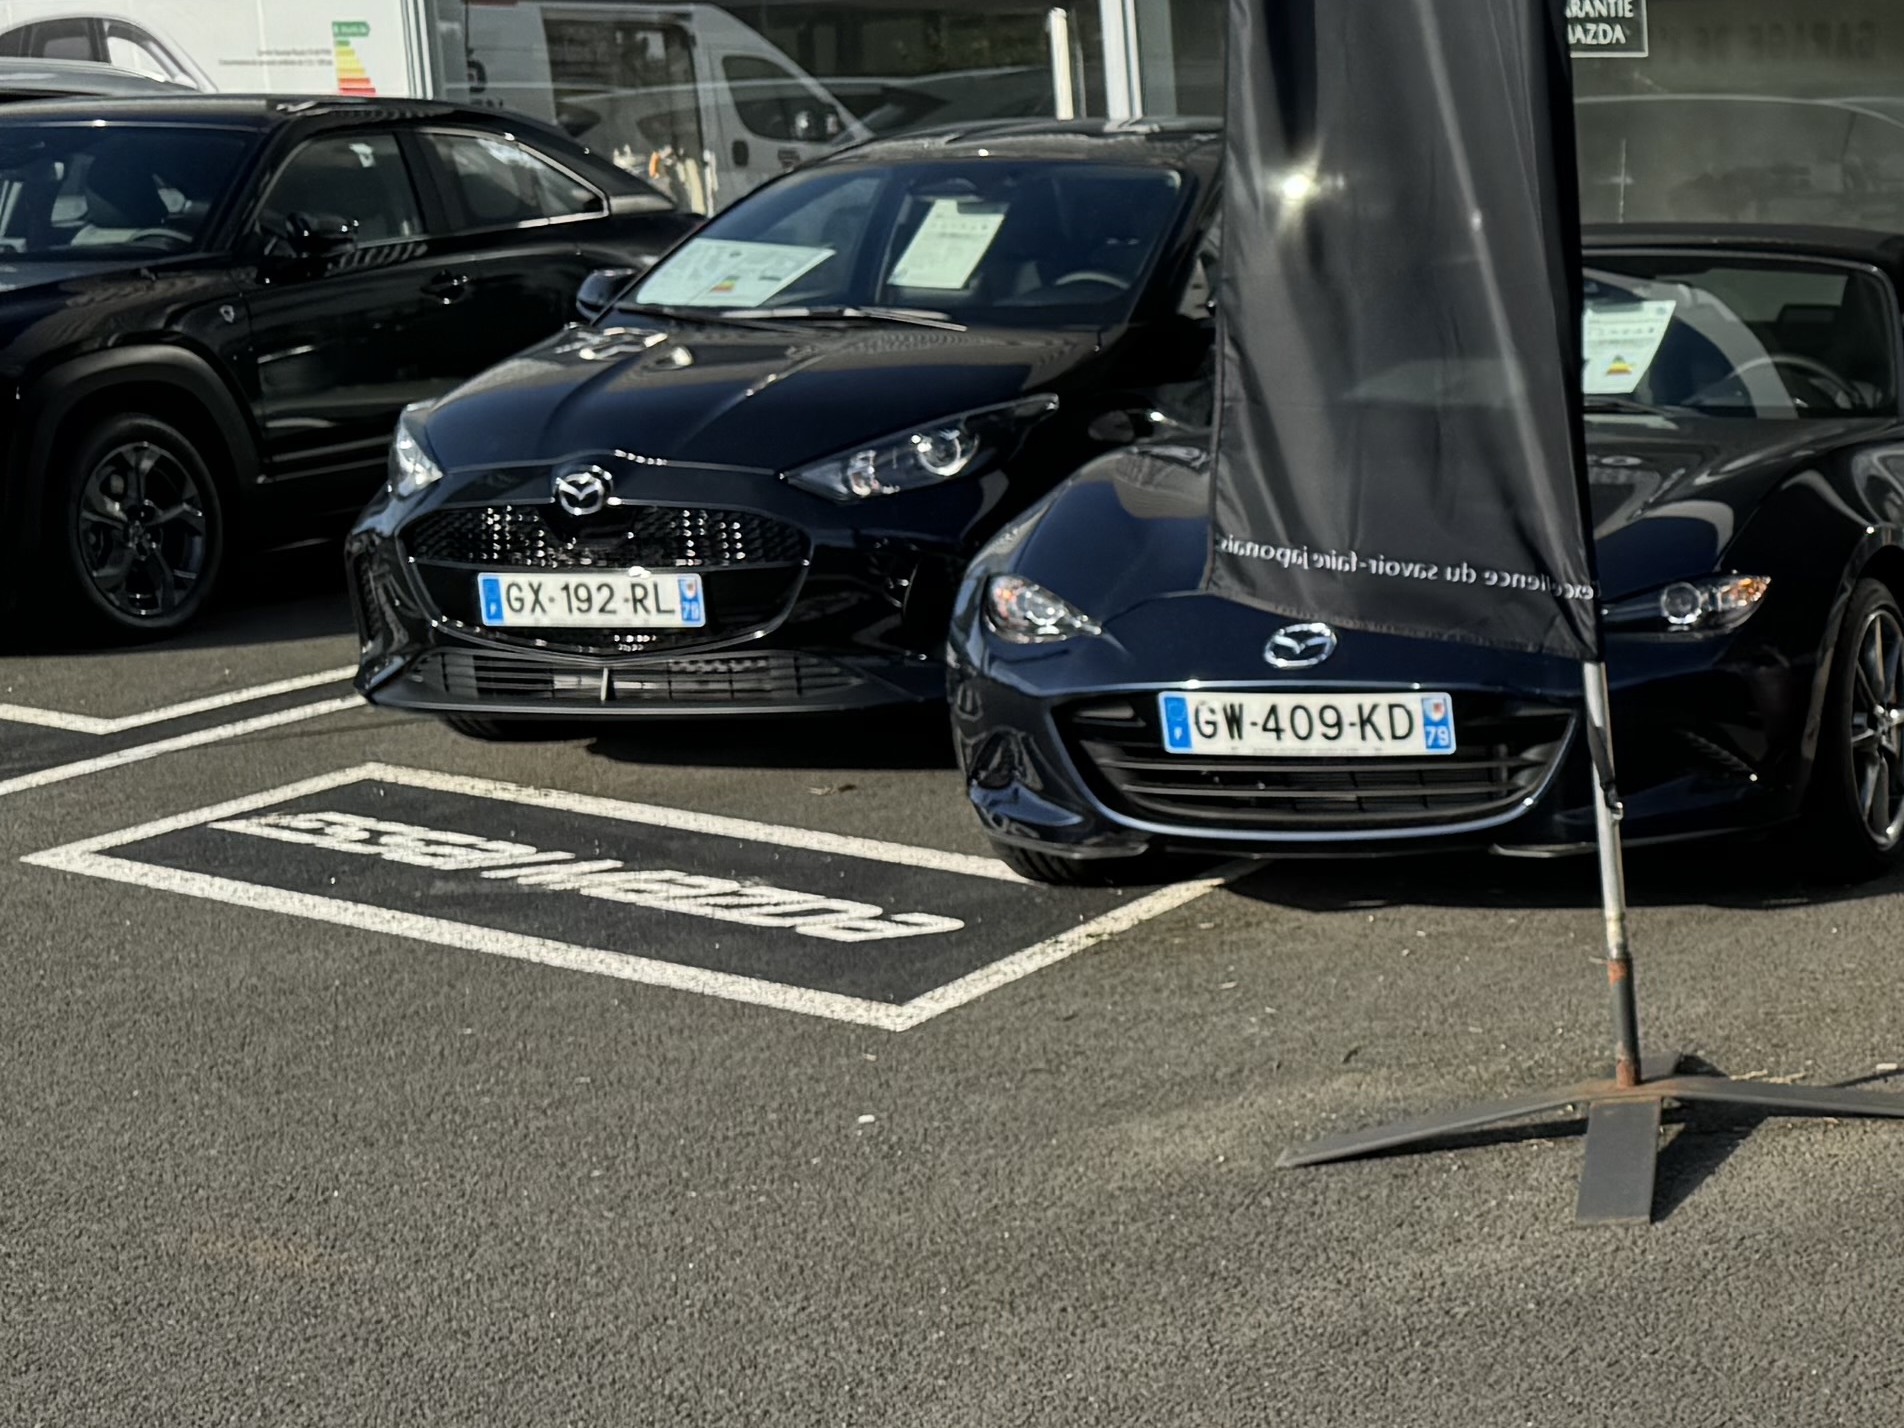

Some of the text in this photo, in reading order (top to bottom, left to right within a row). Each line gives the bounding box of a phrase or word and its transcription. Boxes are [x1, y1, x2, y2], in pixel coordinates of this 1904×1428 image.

[505, 581, 676, 615] GX-192-RL
[1194, 702, 1415, 741] GW-409-KD
[1426, 726, 1450, 747] 79
